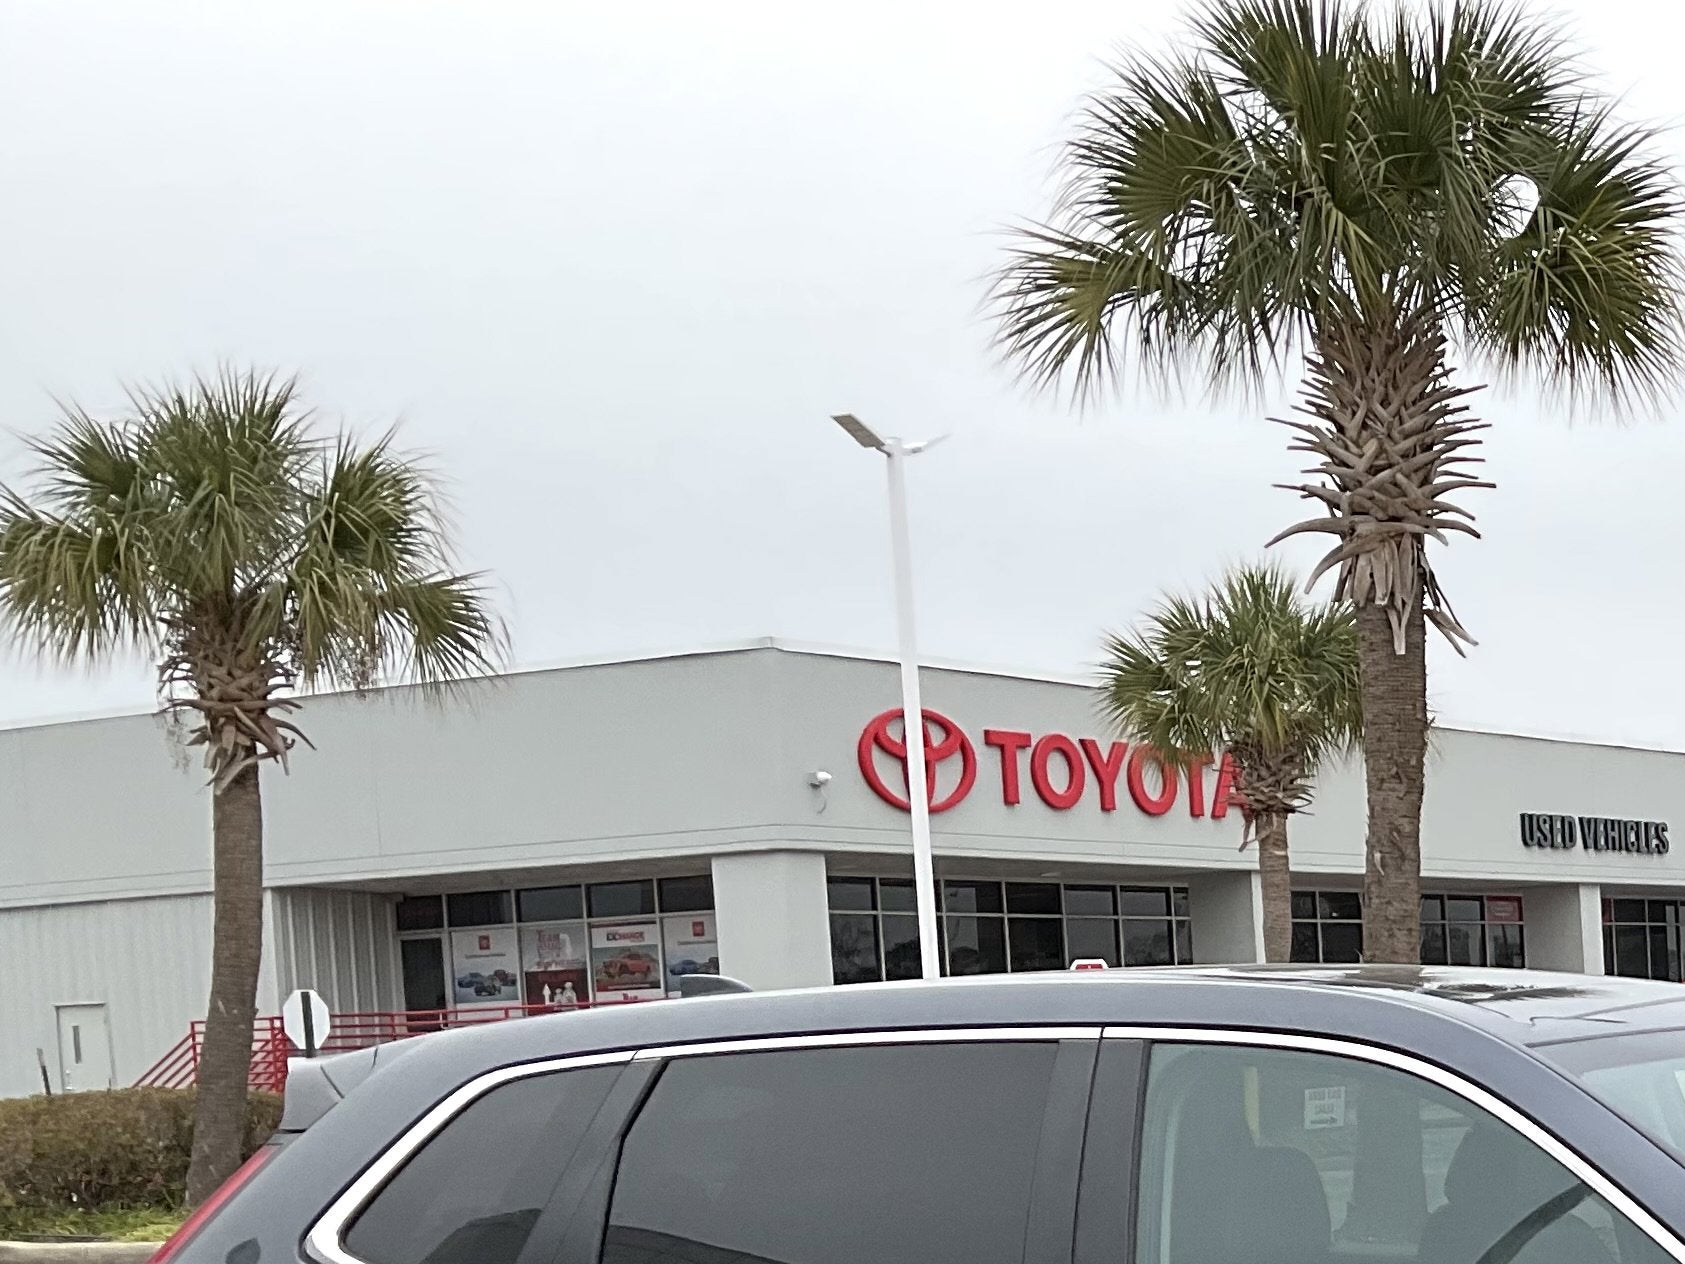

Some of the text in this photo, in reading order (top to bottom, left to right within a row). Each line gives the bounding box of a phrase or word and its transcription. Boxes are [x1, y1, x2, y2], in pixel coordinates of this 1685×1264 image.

[983, 729, 1252, 819] TOYOTA
[1520, 813, 1670, 854] USED VEHICLES
